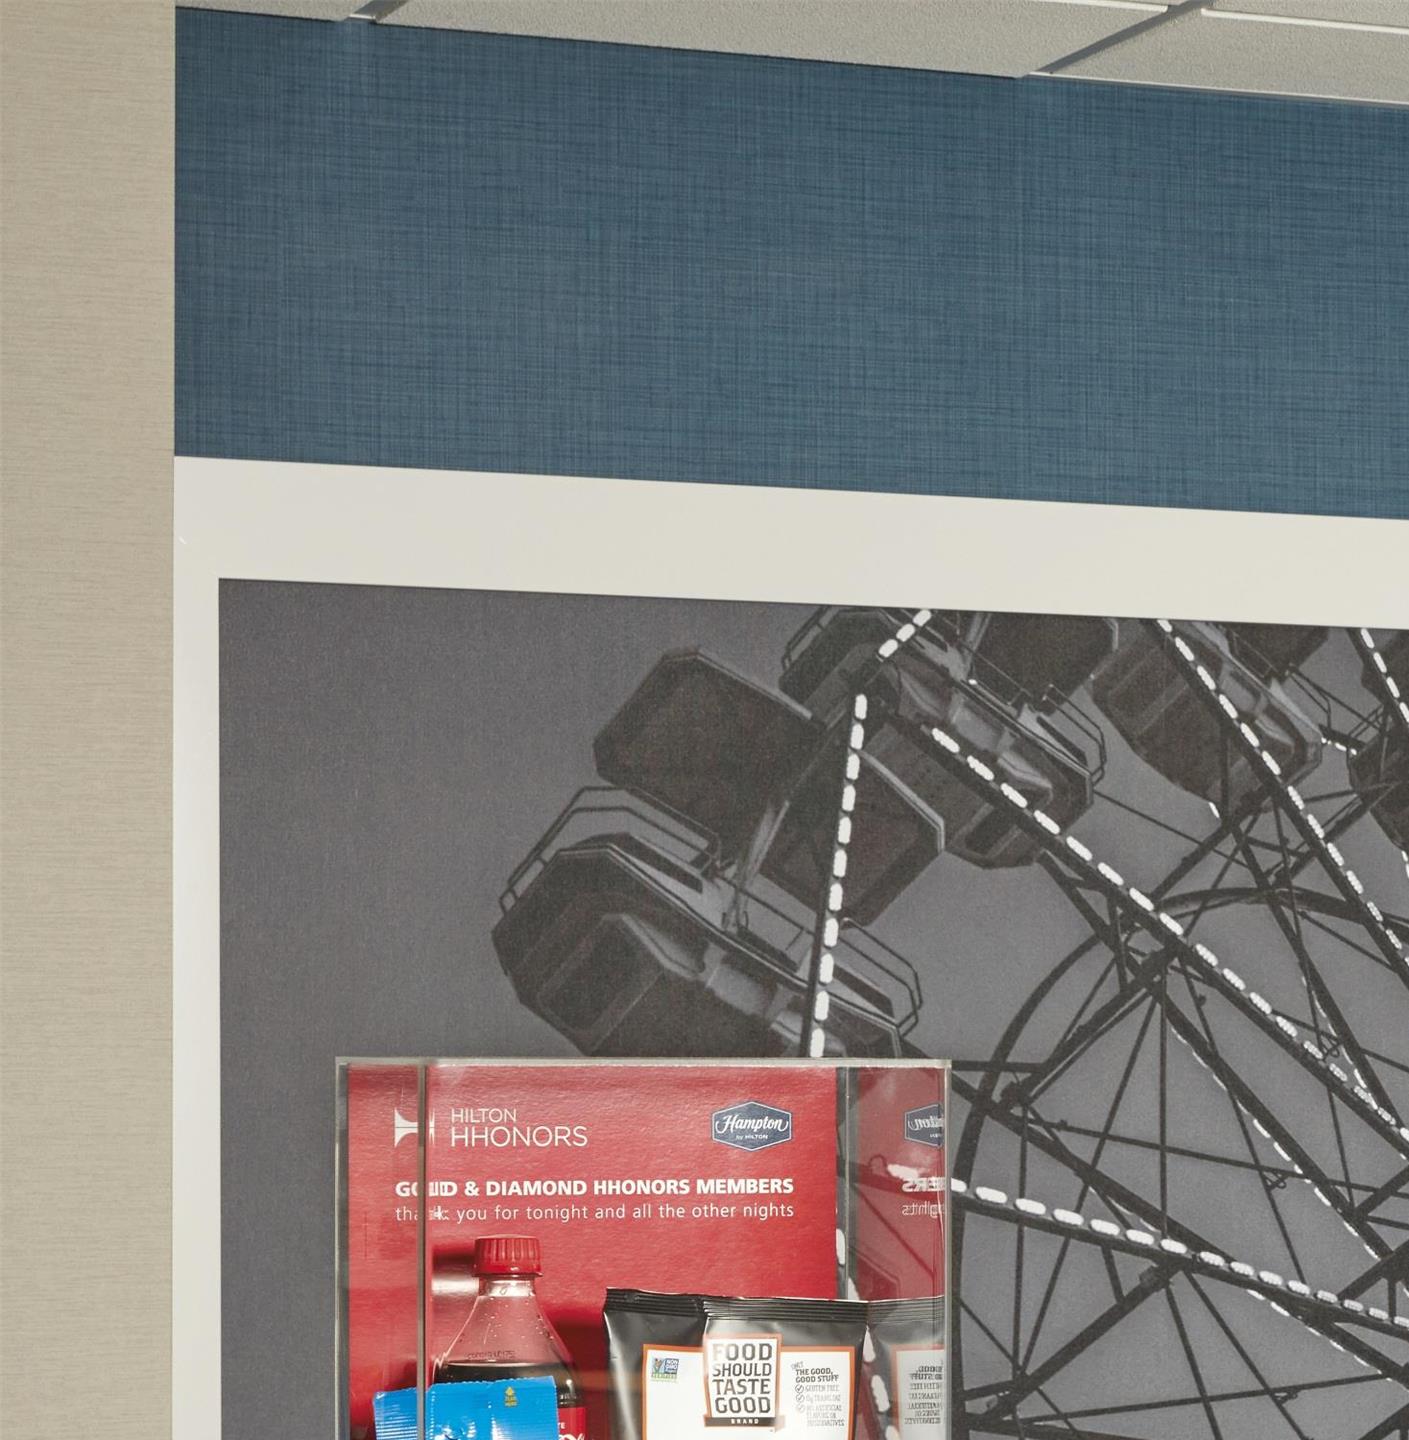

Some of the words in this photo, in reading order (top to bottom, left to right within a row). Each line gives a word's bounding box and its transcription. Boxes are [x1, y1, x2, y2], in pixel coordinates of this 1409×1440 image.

[451, 1108, 517, 1123] HILTON
[715, 1114, 789, 1134] Hampton
[451, 1126, 588, 1147] HHONORS
[464, 1181, 479, 1196] &
[486, 1180, 587, 1196] DIAMOND
[593, 1179, 690, 1195] HHONORS
[696, 1178, 794, 1195] MEMBERS
[457, 1208, 487, 1224] you
[494, 1204, 519, 1220] for
[526, 1204, 588, 1223] tonight
[594, 1203, 625, 1219] and
[632, 1203, 651, 1219] all
[658, 1203, 685, 1218] the
[691, 1203, 736, 1218] other
[743, 1202, 794, 1221] nights
[712, 1343, 773, 1361] FOOD
[712, 1363, 771, 1377] SHOULD
[817, 1374, 839, 1382] STUFF
[712, 1378, 771, 1395] TASTE
[715, 1397, 771, 1414] GOOD
